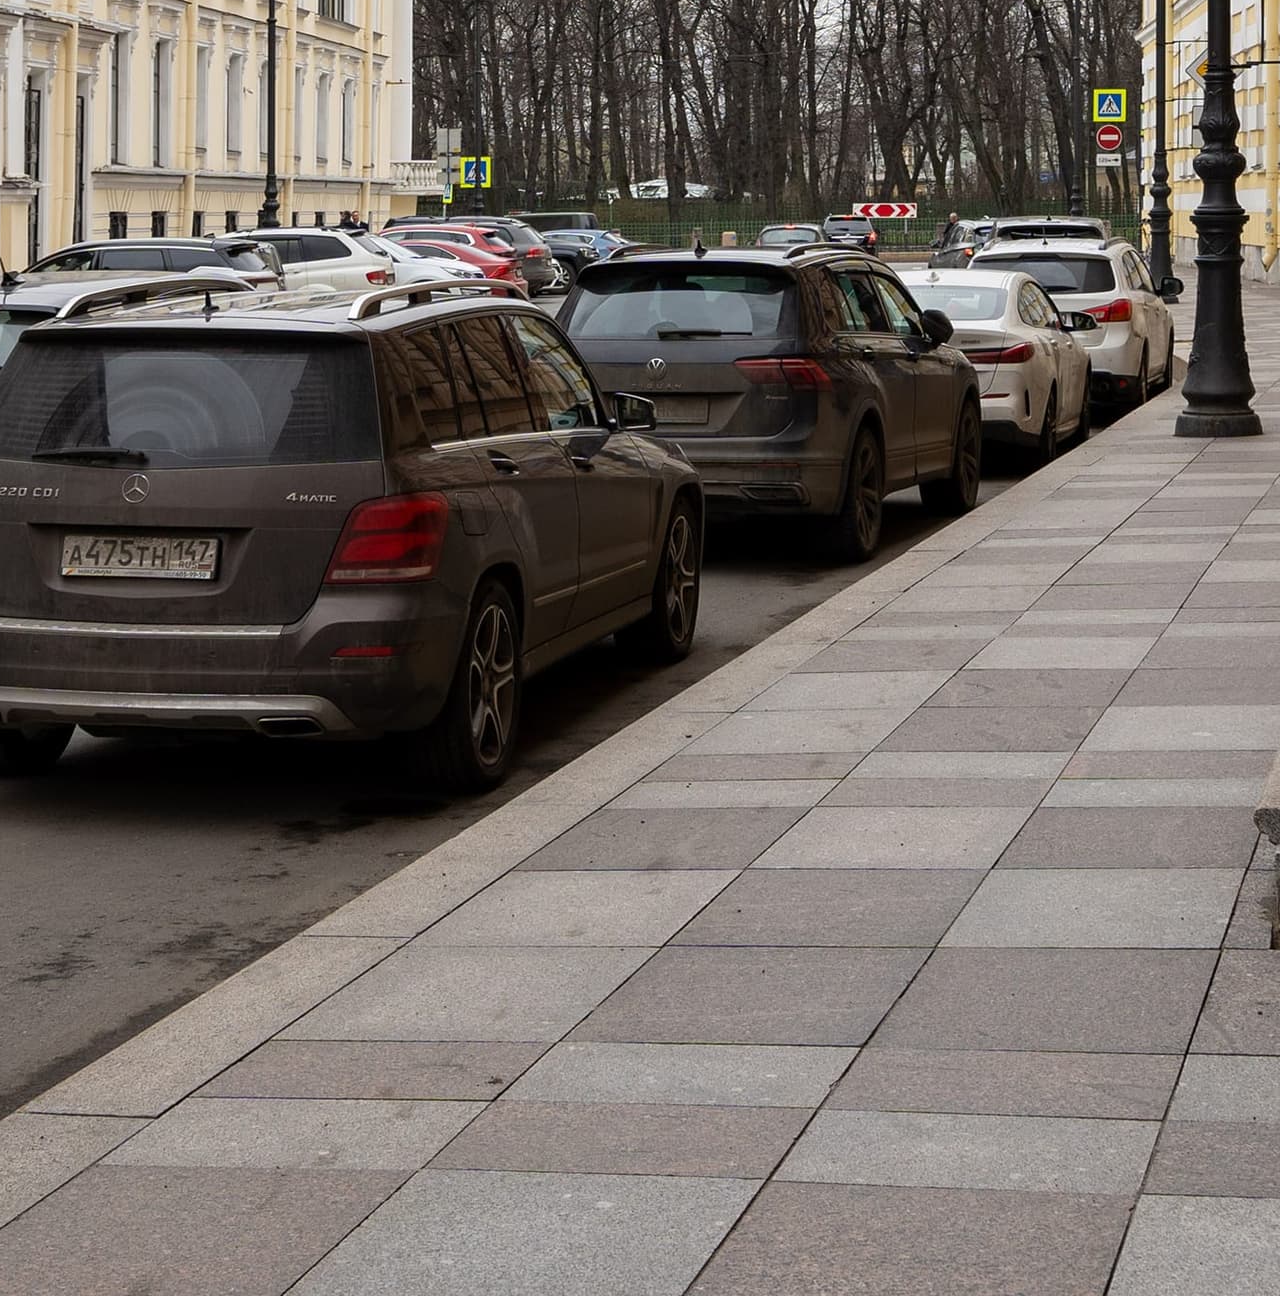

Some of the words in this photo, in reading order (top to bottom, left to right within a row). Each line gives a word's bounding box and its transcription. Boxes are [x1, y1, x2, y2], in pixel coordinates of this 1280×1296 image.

[32, 487, 60, 498] CDI
[68, 539, 166, 568] А475ТН
[173, 540, 211, 562] 147
[178, 560, 198, 570] RUS
